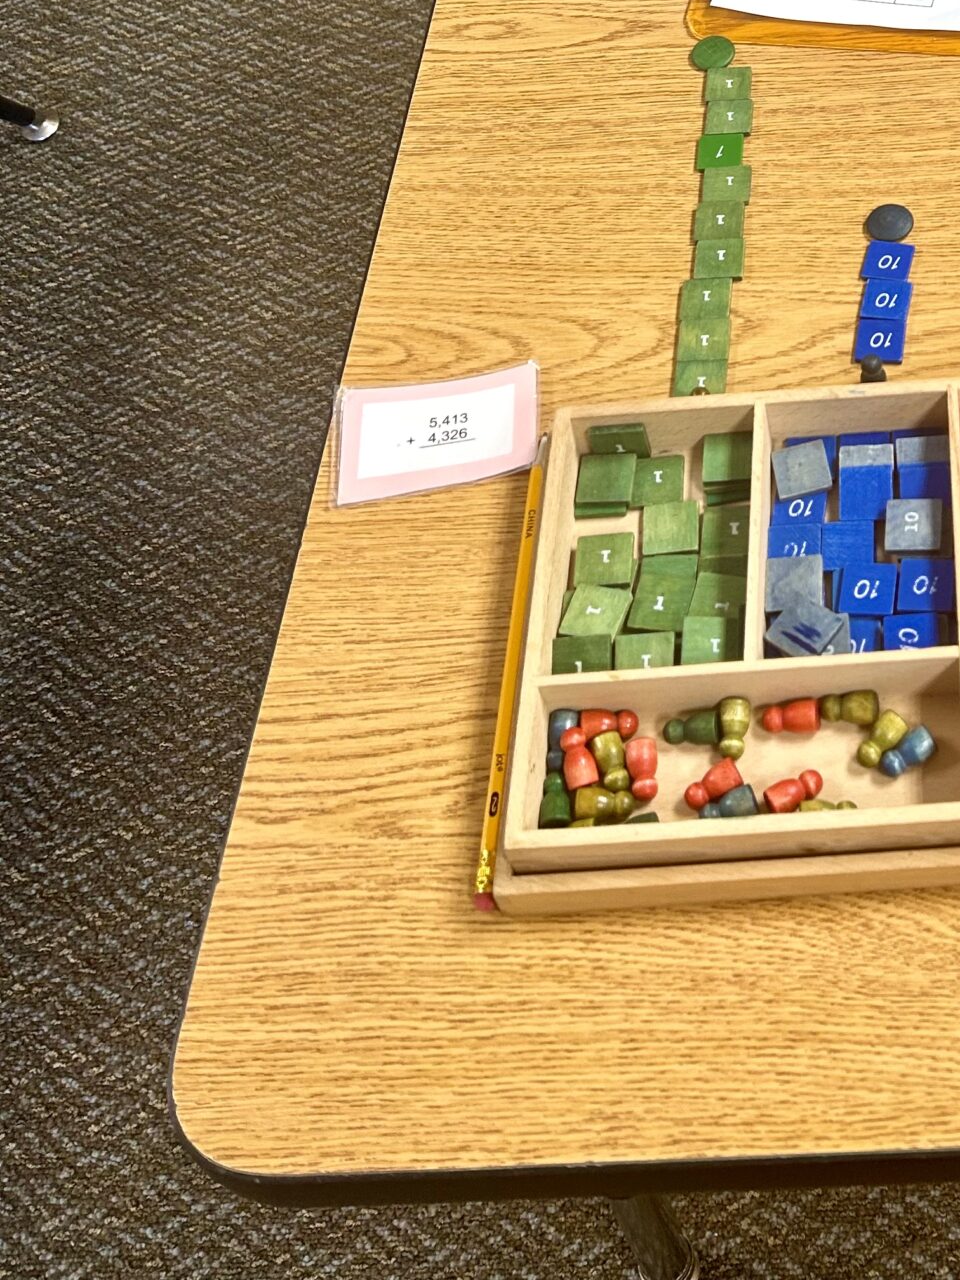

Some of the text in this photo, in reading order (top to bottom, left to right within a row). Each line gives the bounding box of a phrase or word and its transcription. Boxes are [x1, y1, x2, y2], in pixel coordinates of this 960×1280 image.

[726, 80, 733, 88] 1
[726, 112, 734, 121] 1
[715, 145, 724, 158] 1
[726, 176, 734, 185] 1
[716, 214, 725, 225] 1
[717, 250, 726, 260] 1
[878, 255, 901, 270] 10
[703, 291, 711, 301] 1
[875, 293, 898, 308] 10
[701, 335, 709, 346] 1
[870, 332, 892, 348] 10
[697, 376, 706, 387] 1
[429, 413, 469, 429] 5,413
[428, 428, 467, 445] 4,326
[653, 470, 663, 483] 1
[788, 499, 814, 517] 10
[525, 509, 536, 539] CHINA
[729, 522, 740, 535] 1
[904, 511, 919, 532] 10
[601, 549, 611, 563] 1
[854, 580, 880, 599] 10
[913, 575, 938, 595] 10
[586, 605, 601, 615] 1
[653, 596, 664, 611] 1
[710, 638, 721, 652] 1
[641, 654, 652, 668] 1
